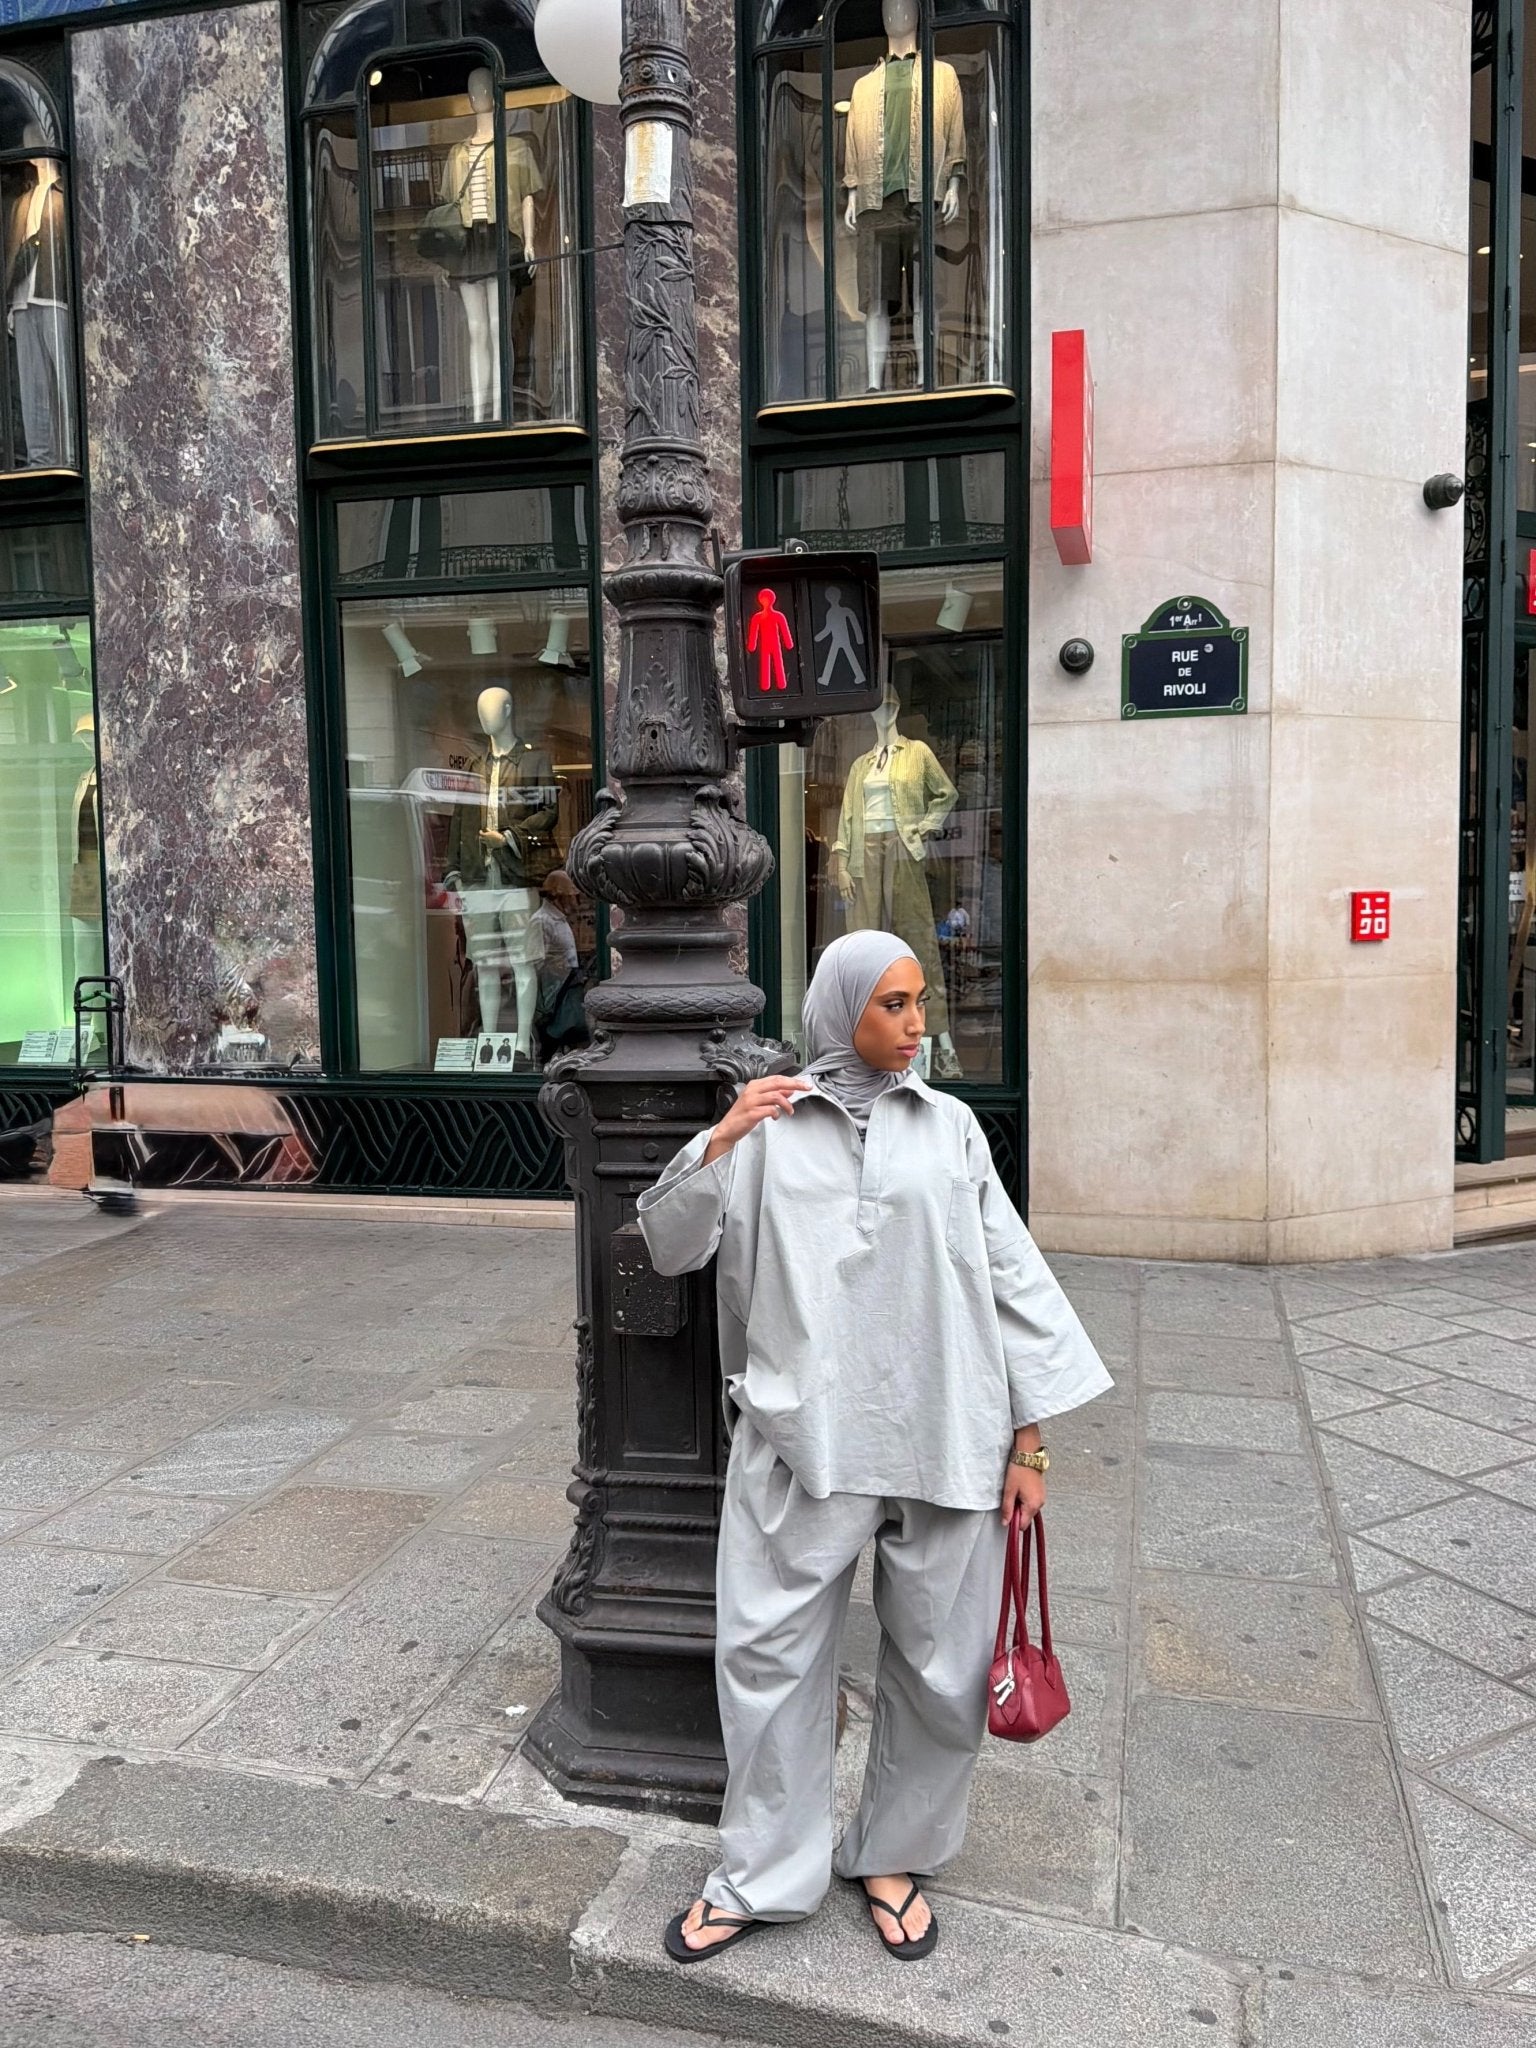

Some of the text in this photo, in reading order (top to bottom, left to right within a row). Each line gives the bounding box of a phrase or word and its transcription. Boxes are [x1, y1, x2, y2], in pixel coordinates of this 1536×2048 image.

[1169, 614, 1183, 627] 1er
[1171, 650, 1199, 662] RUE
[1178, 667, 1192, 677] DE
[1163, 683, 1206, 696] RIVOLI
